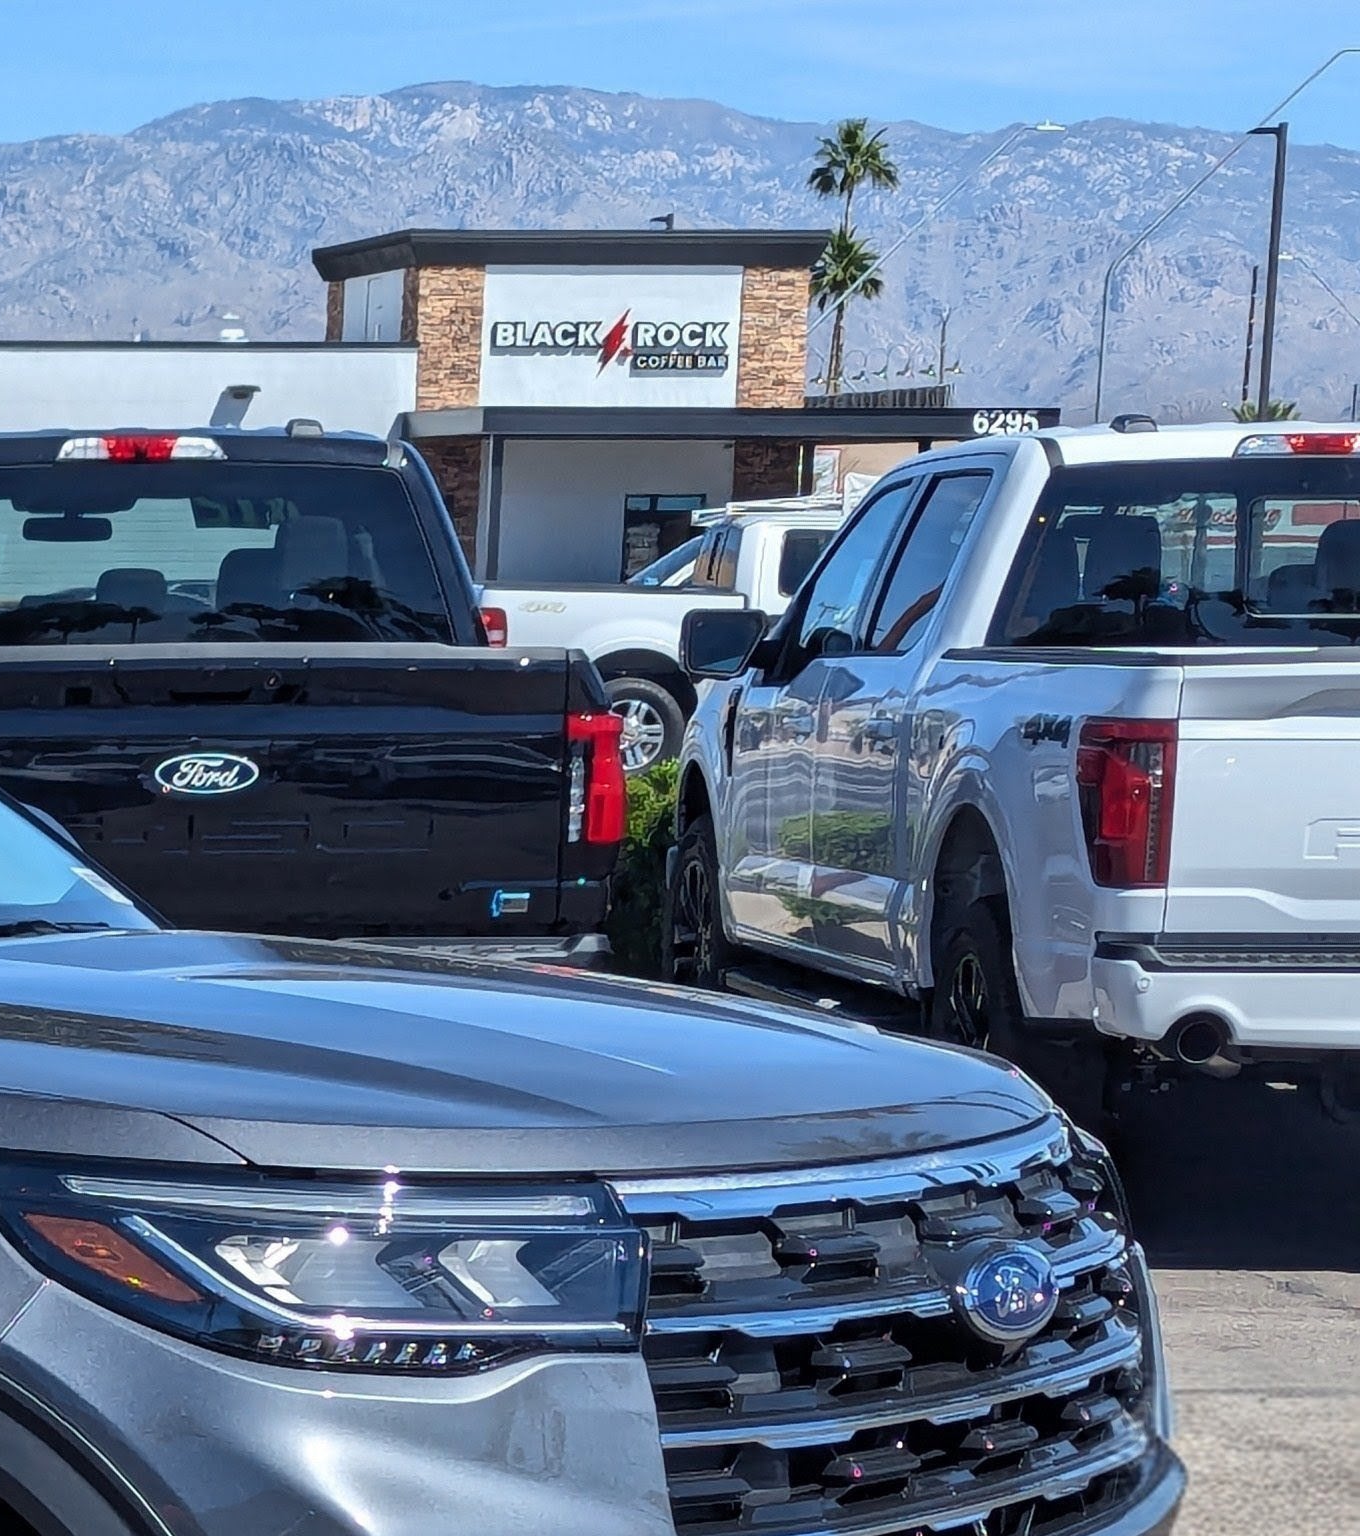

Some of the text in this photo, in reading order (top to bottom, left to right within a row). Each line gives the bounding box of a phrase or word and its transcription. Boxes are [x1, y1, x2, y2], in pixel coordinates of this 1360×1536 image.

[495, 322, 728, 347] BLACK ROCK
[637, 354, 727, 369] COFFEE BAR
[972, 409, 1040, 435] 6295
[172, 759, 241, 788] Ford
